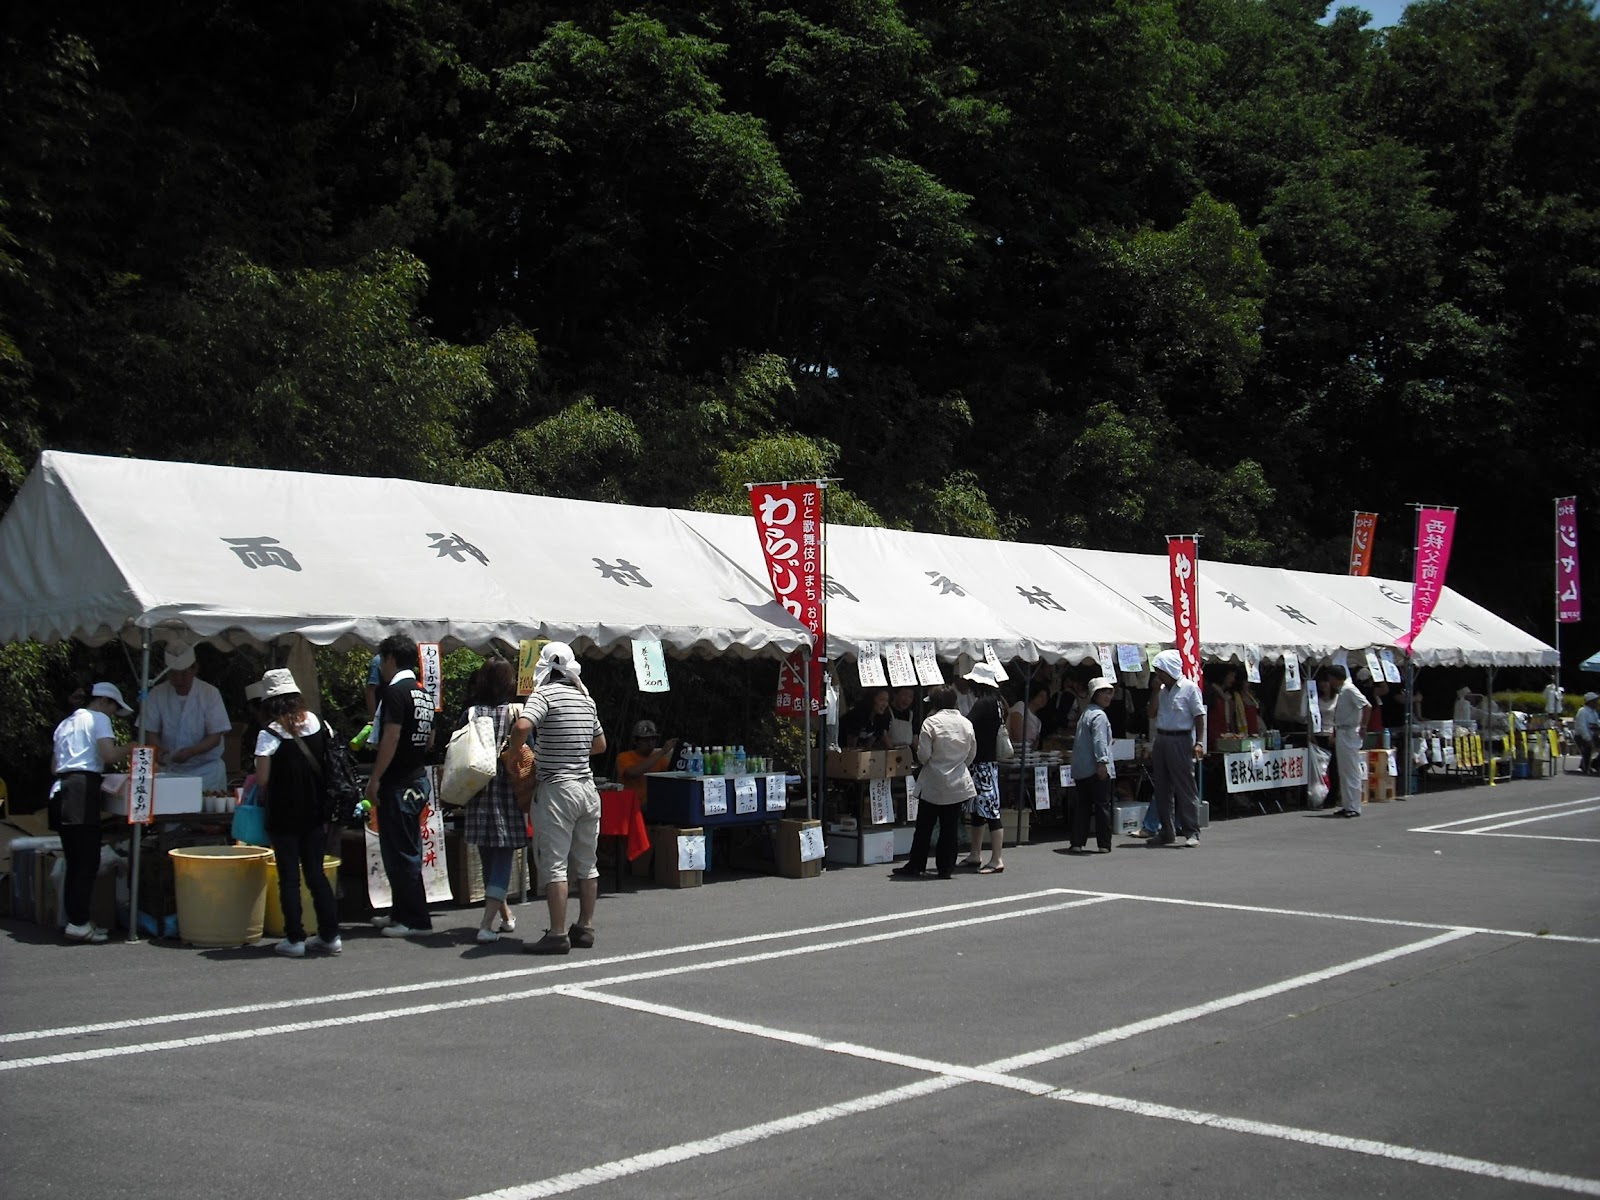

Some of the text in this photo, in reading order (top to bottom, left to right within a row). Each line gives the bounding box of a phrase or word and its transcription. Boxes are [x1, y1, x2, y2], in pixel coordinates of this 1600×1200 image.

[802, 492, 816, 601] 花と歌舞伎のまち
[134, 748, 149, 813] きゅうり塩もみ
